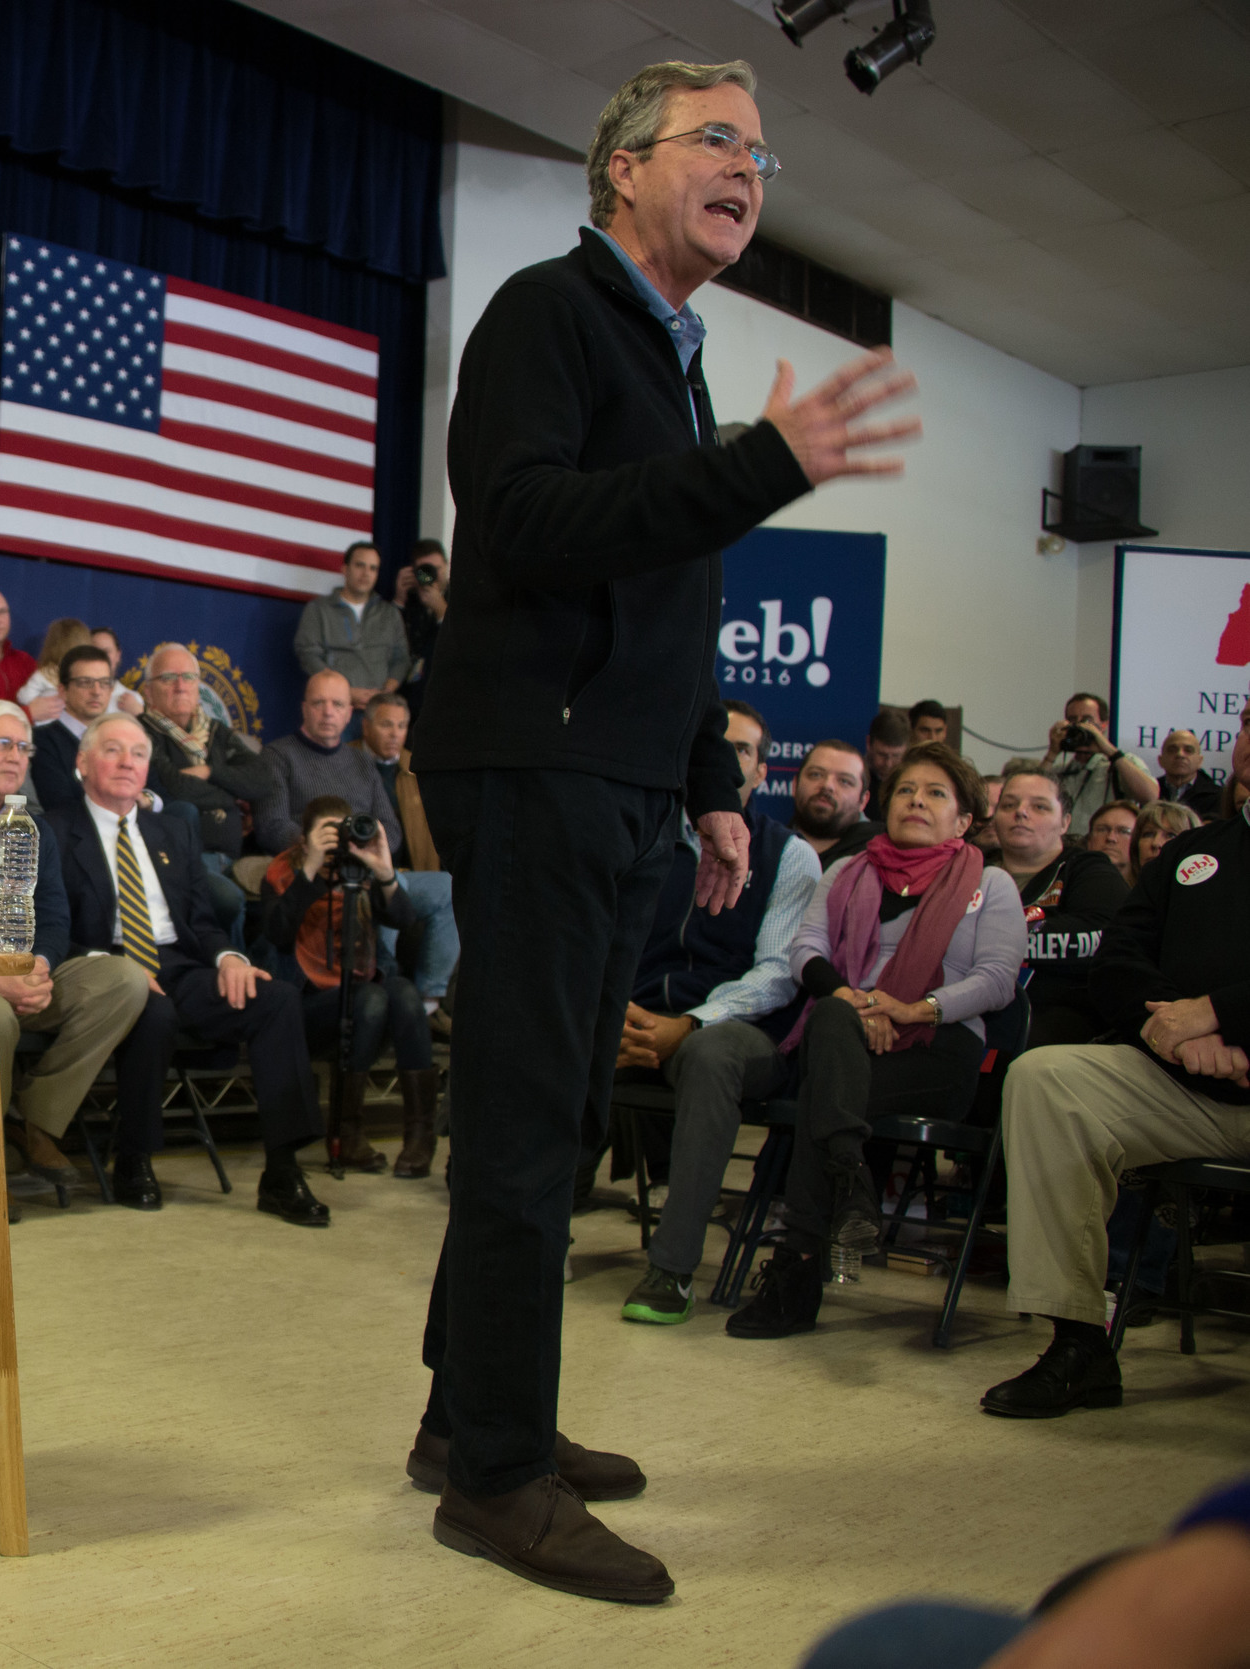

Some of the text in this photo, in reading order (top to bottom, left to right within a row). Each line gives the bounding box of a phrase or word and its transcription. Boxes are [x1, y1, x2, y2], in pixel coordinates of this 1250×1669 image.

[718, 595, 833, 687] eb!
[723, 665, 791, 686] 2016
[1179, 855, 1215, 883] Jeb!
[1023, 929, 1103, 960] RLEY-DA
